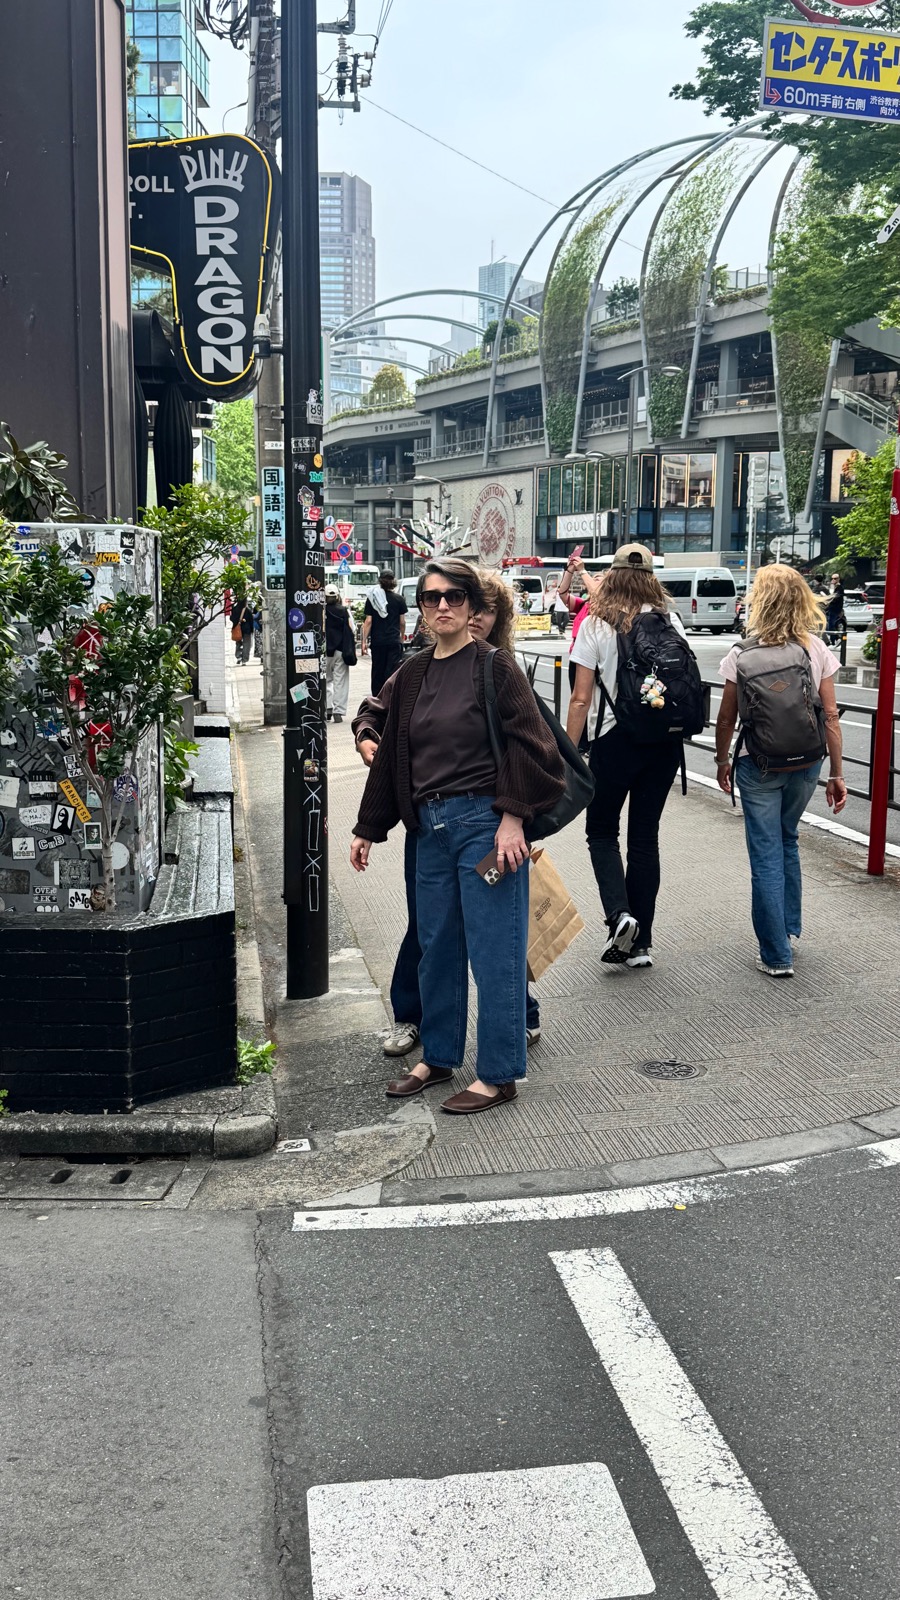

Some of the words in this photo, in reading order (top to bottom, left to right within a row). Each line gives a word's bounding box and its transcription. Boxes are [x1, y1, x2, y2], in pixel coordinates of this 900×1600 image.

[179, 148, 249, 194] PINK
[194, 196, 246, 374] DRAGON
[479, 485, 505, 503] VUITTON
[294, 645, 314, 653] PSL
[61, 780, 90, 822] FRANCHISE
